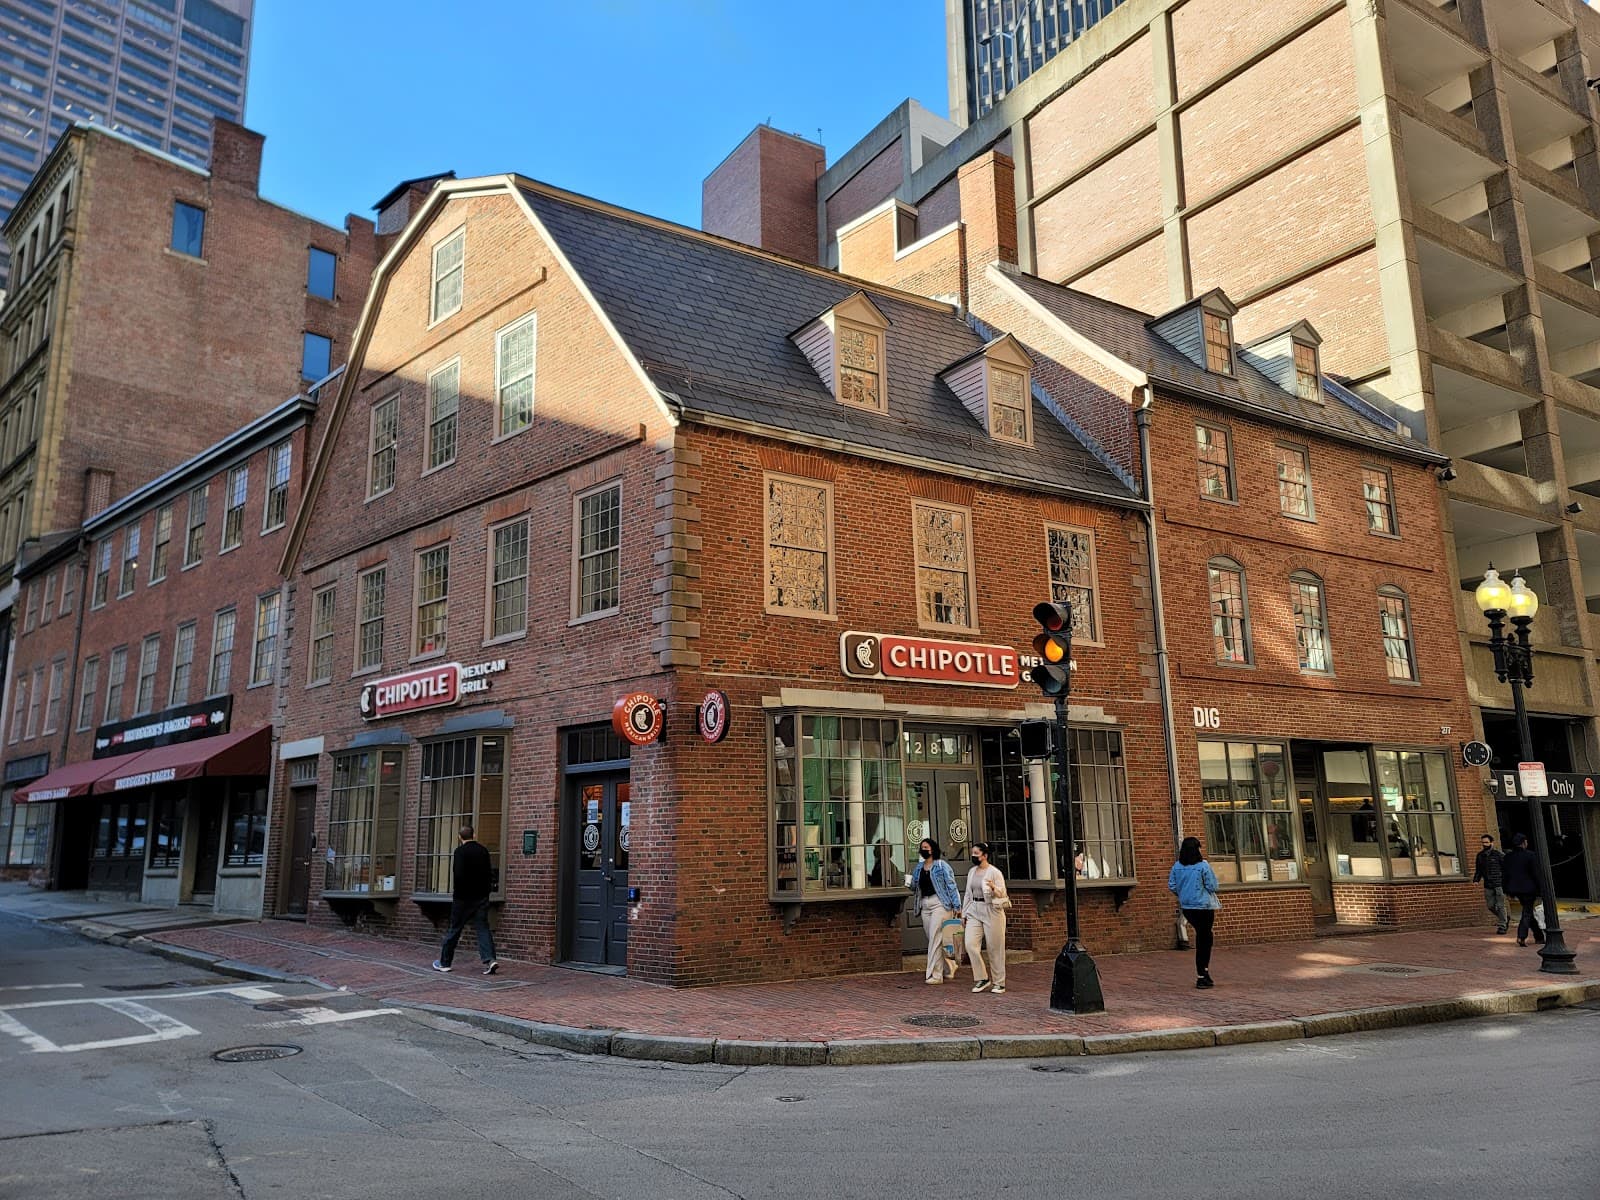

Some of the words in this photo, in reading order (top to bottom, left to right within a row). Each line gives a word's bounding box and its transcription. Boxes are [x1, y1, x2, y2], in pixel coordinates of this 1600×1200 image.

[461, 659, 506, 679] MEXICAN
[889, 645, 1015, 676] CHIPOTLE
[375, 673, 449, 706] CHIPOTLE
[460, 678, 489, 694] GRILL
[624, 694, 661, 714] CHIPOTLE
[1192, 706, 1220, 729] DIG
[1551, 779, 1575, 798] Only
